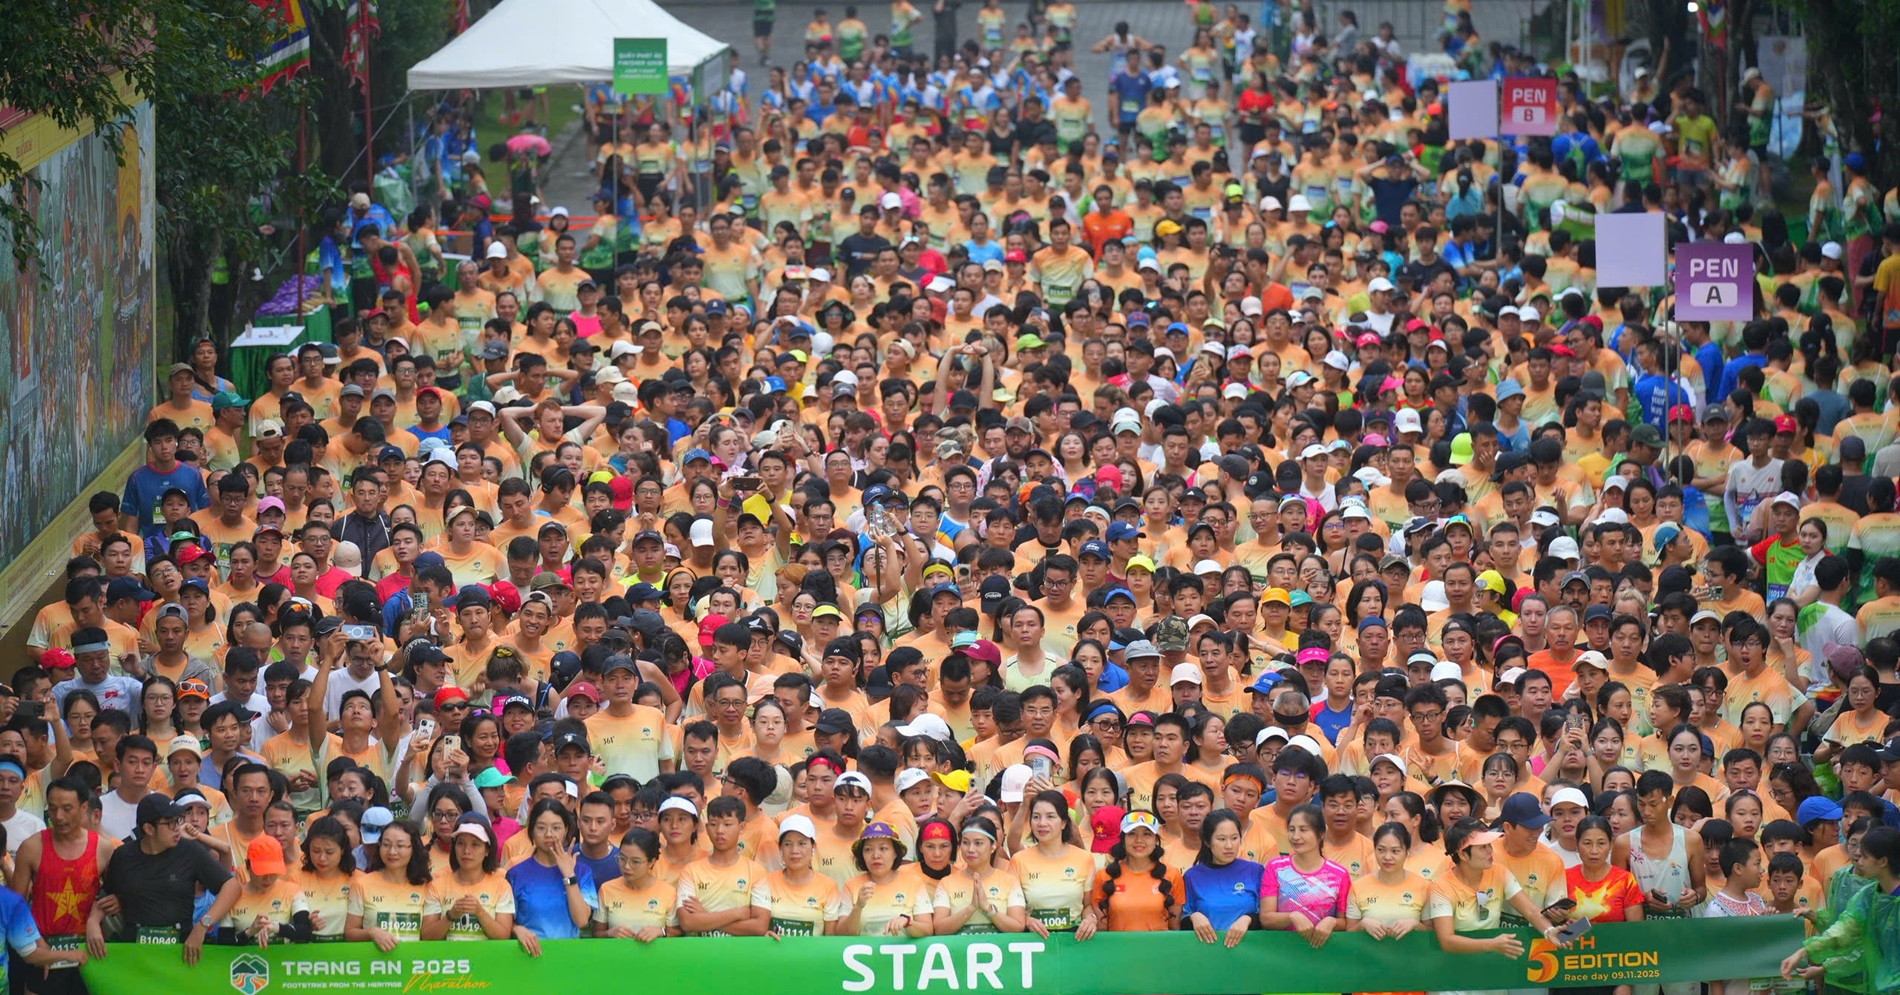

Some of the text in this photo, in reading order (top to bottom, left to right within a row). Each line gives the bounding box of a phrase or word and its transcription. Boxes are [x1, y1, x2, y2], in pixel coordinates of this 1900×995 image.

[1513, 88, 1546, 103] PEN
[1524, 109, 1533, 122] B
[1690, 258, 1738, 278] PEN
[1706, 285, 1722, 304] A
[380, 921, 418, 931] B10222
[1039, 916, 1067, 927] 1004
[282, 959, 471, 975] TRANG AN 2025
[842, 942, 1046, 991] START
[1564, 951, 1659, 970] EDITION
[403, 971, 492, 994] Marathon
[1564, 970, 1660, 982] Race day 09.11.2025
